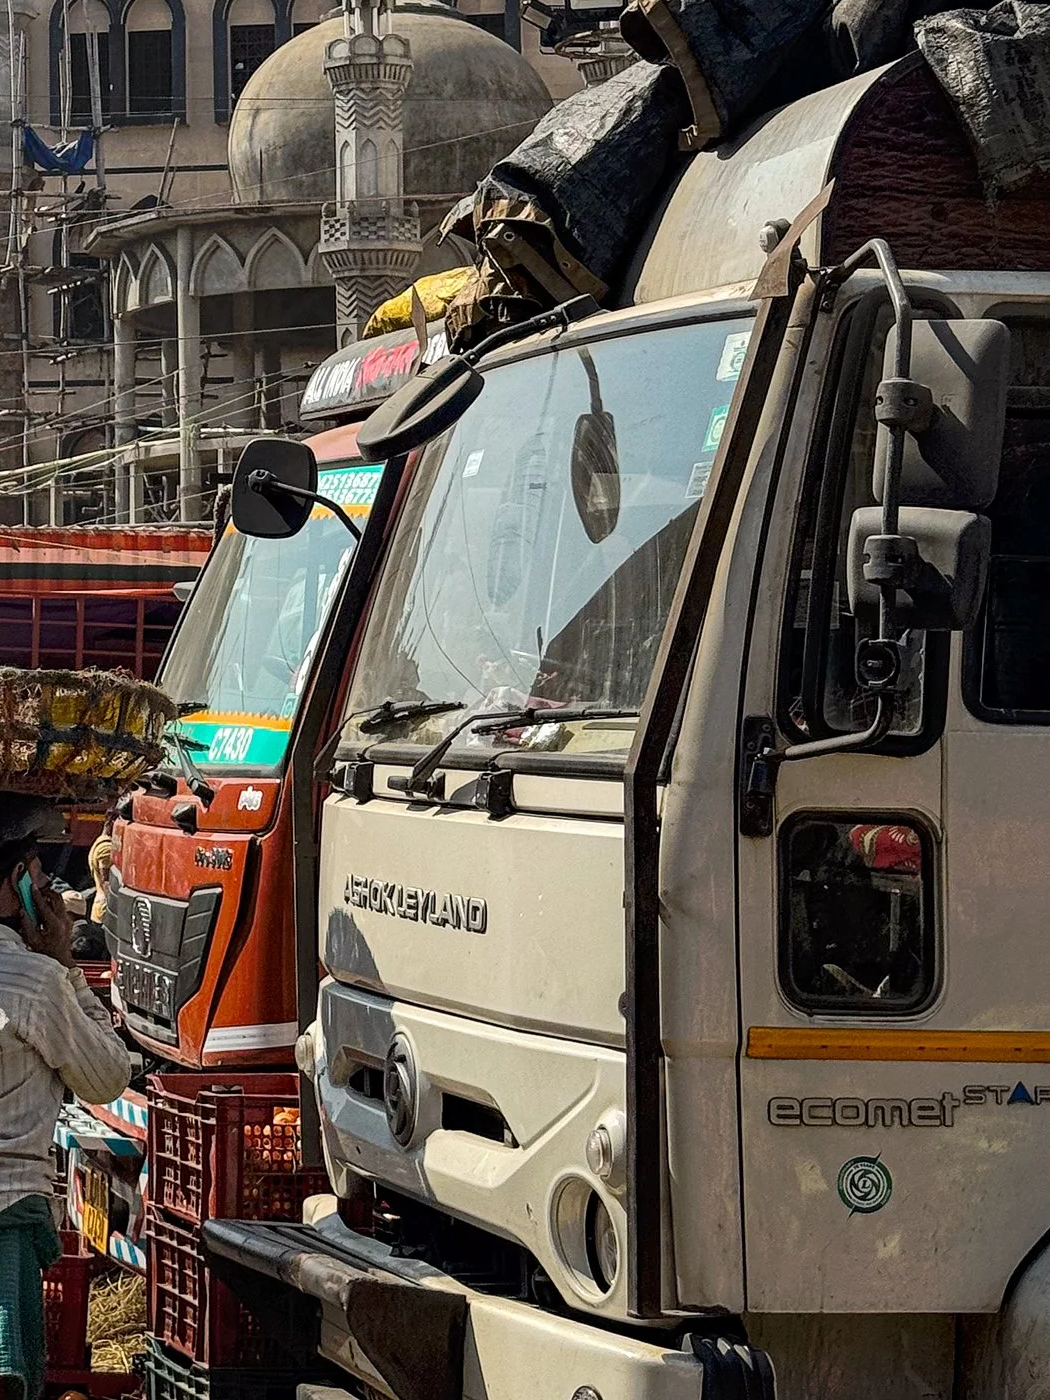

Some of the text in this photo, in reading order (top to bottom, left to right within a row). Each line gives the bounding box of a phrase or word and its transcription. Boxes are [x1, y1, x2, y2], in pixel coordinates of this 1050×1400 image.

[303, 366, 331, 405] ALL
[323, 356, 362, 399] INDIA
[344, 873, 488, 934] ASHOK LEYLAND
[767, 1091, 960, 1128] ecomet
